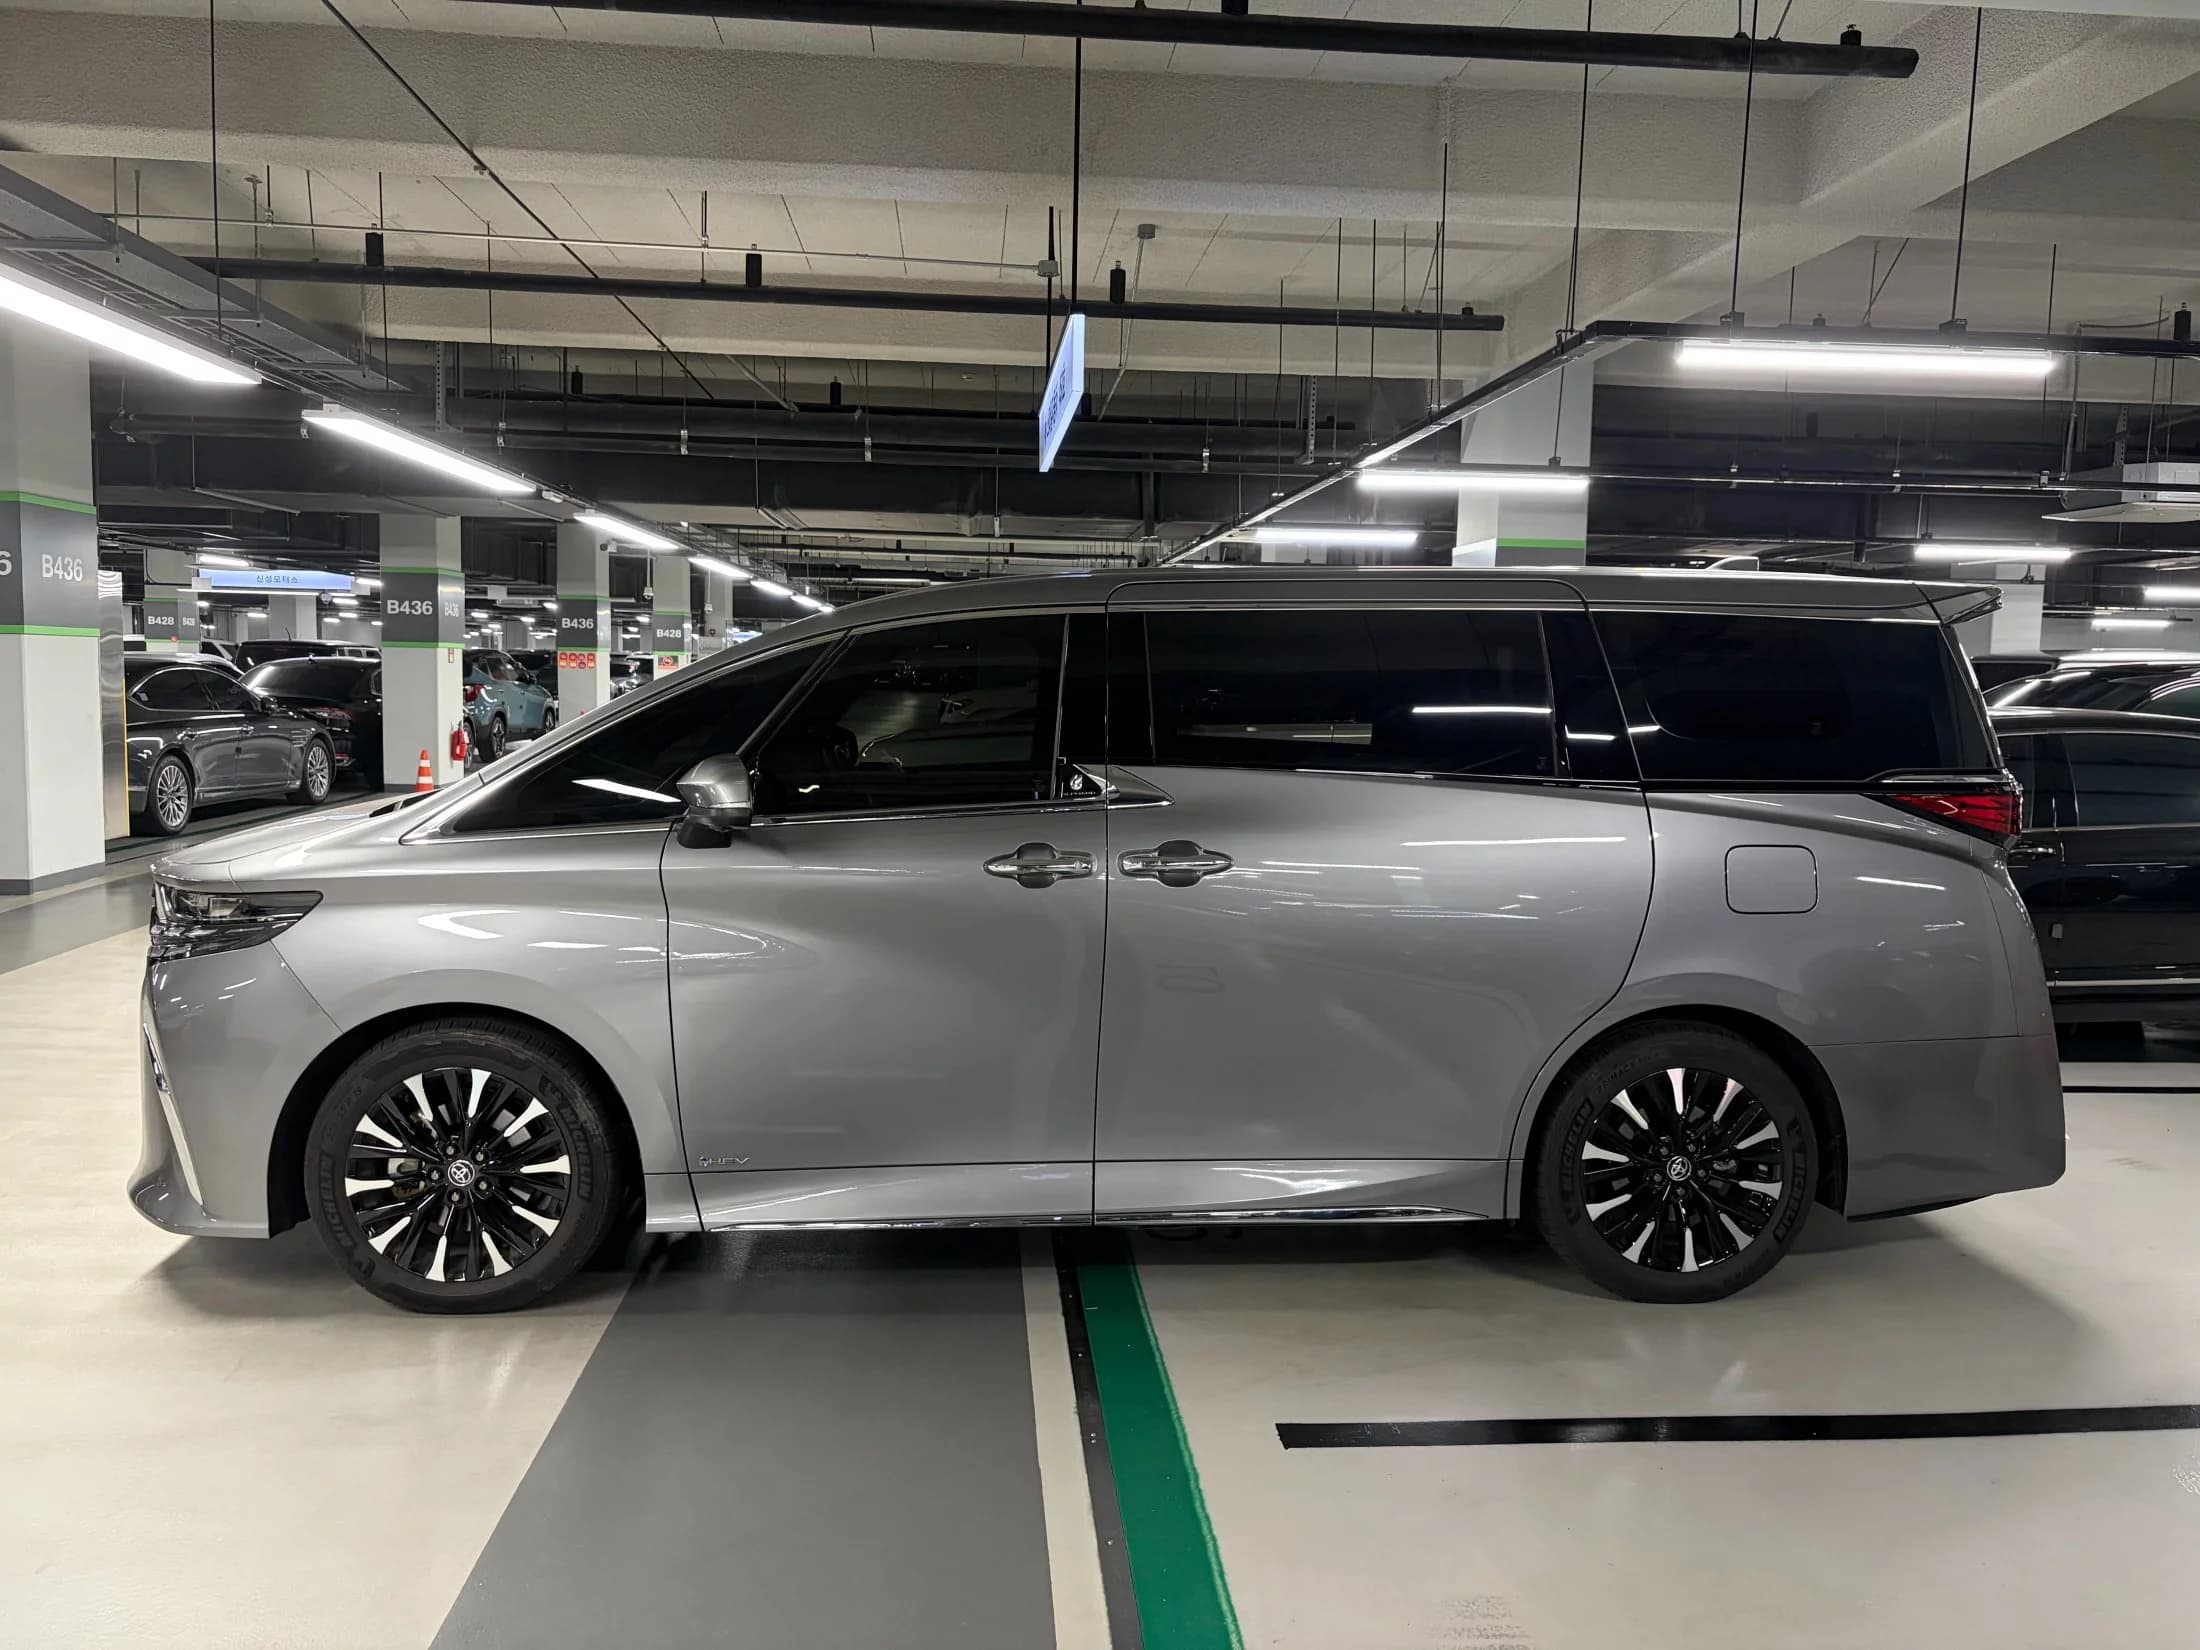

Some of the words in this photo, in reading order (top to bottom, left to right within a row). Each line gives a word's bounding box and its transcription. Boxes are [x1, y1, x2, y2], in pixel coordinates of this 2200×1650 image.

[42, 553, 83, 581] B436
[387, 600, 433, 615] B436
[147, 616, 175, 625] B428
[562, 618, 594, 629] B436
[656, 629, 682, 638] B428
[559, 1105, 593, 1199] MICHELIN
[1561, 1100, 1592, 1191] MICHELIN
[709, 1157, 750, 1165] HEV
[320, 1154, 354, 1247] MICHELIN
